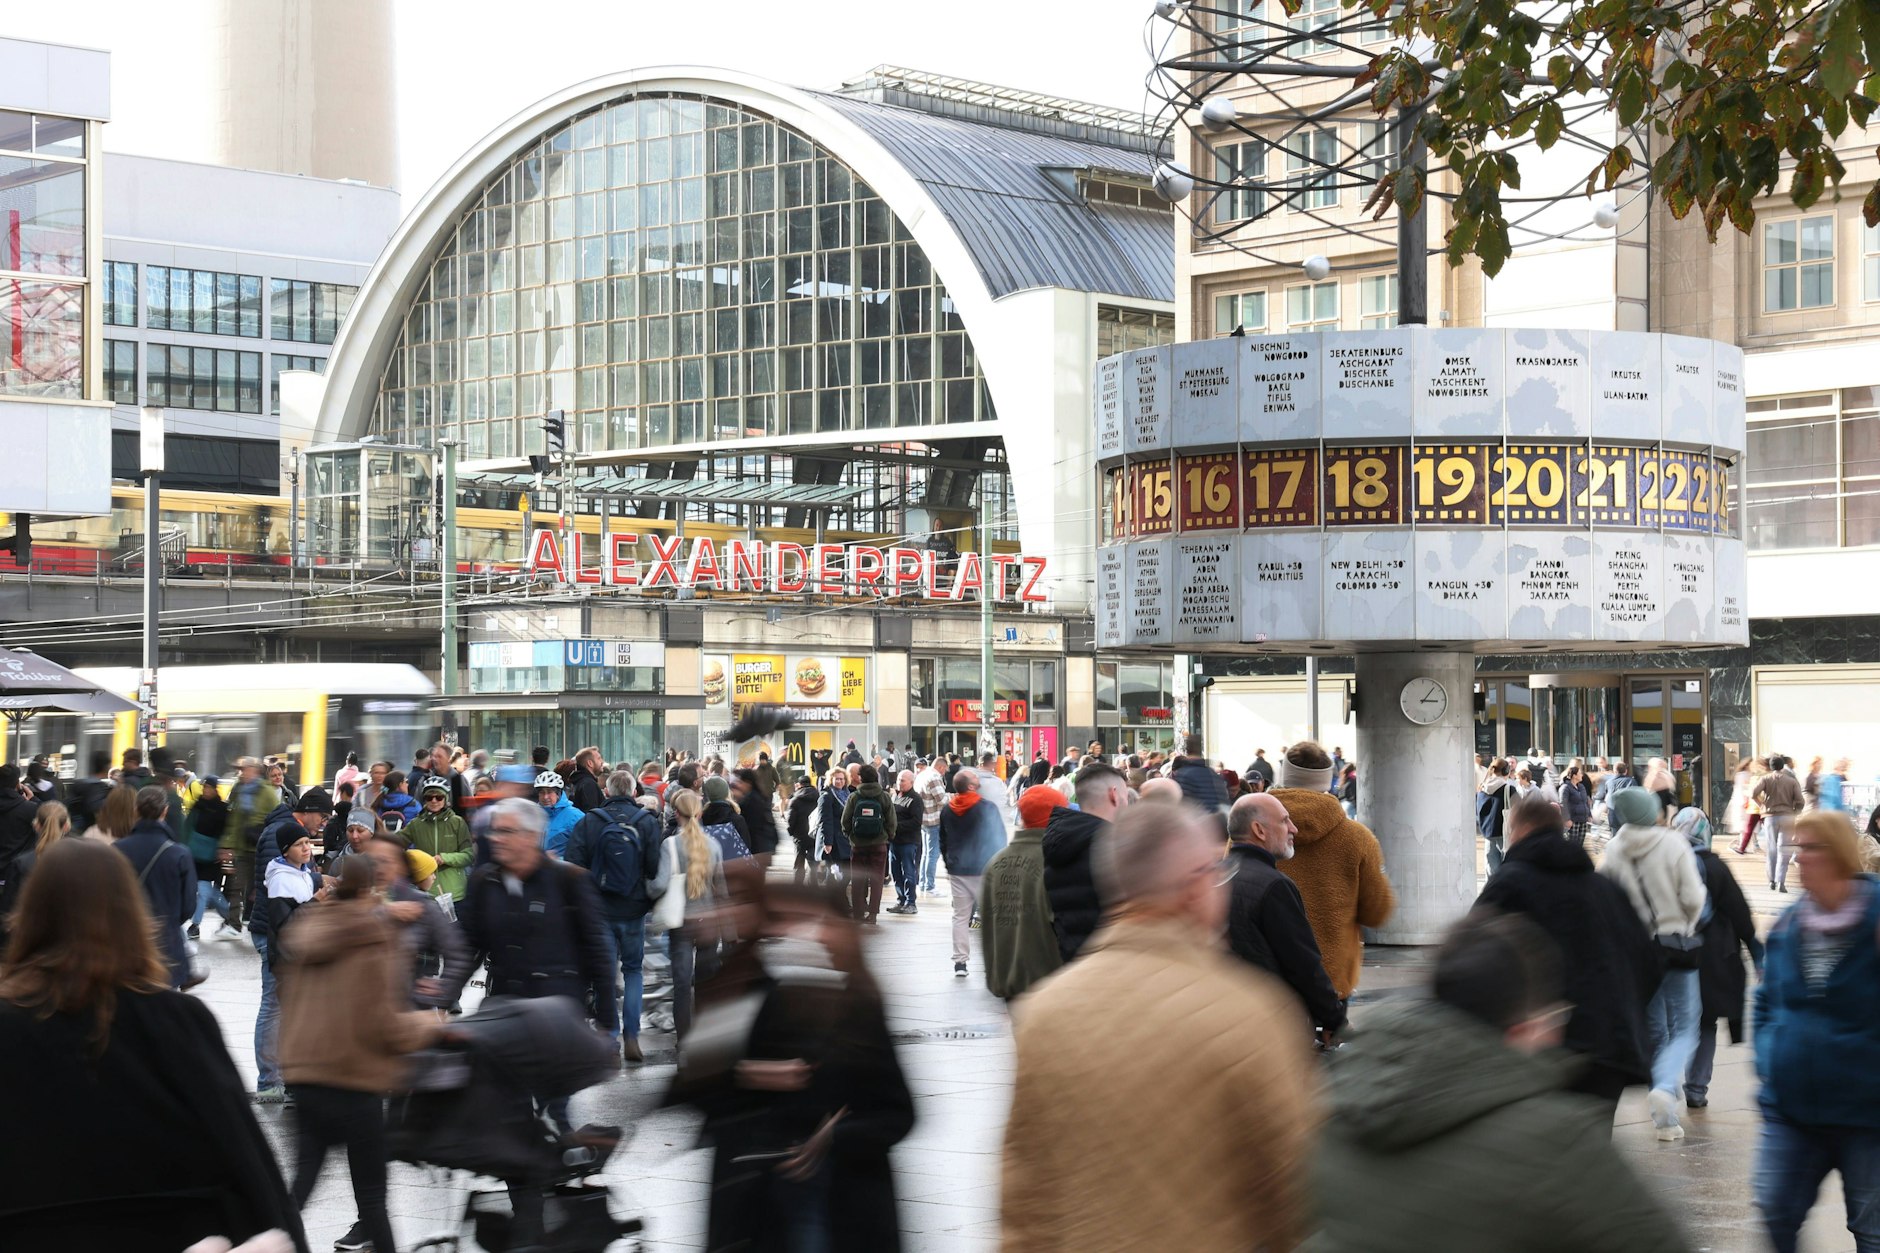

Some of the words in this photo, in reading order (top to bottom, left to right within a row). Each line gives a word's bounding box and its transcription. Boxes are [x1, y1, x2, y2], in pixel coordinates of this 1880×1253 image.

[1251, 342, 1289, 351] NISCHNIJ
[1265, 352, 1307, 361] NOWGOROD
[1330, 348, 1402, 357] JEKATERINBURG
[1136, 355, 1157, 365] HELSINKI
[1339, 359, 1394, 367] ASCHGABAT
[1517, 358, 1577, 366] KRASNOJARSK
[1141, 366, 1152, 374] RIGA
[1185, 367, 1223, 378] MURMANSK
[1345, 369, 1387, 378] BISCHKEK
[1676, 365, 1699, 374] JAKUTSK
[1255, 372, 1304, 382] WOLGOGRAD
[1612, 371, 1641, 379] IRKUTSK
[1137, 375, 1156, 384] TALLINN
[1190, 377, 1228, 387] PETERSBURG
[1339, 379, 1393, 388] DUSCHANBE
[1432, 378, 1485, 386] TASCHKENT
[1139, 386, 1154, 394] WILNA
[1191, 388, 1218, 397] MOSKAU
[1268, 393, 1291, 402] TIFLIS
[1603, 391, 1649, 401] ULAN-BATOR
[1264, 404, 1294, 412] ERIWAN
[1135, 414, 1159, 425] BUKAREST
[1142, 471, 1171, 519] 15
[1186, 465, 1231, 513] 16
[1250, 460, 1306, 509] 17
[1328, 458, 1389, 508] 18
[1414, 457, 1475, 506] 19
[1492, 457, 1564, 507] 20
[1577, 459, 1626, 507] 21
[1641, 461, 1687, 511] 22
[1181, 545, 1213, 553] TEHERAN
[1193, 555, 1219, 563] BAGDAD
[1616, 551, 1640, 559] PEKING
[529, 529, 1048, 602] ALEXANDERPLATZ
[1137, 558, 1159, 567] ISTANBUL
[1674, 563, 1704, 572] PJÖNGJANG
[1260, 573, 1303, 581] MAURITIUS
[1347, 571, 1389, 579] KARACHI
[1614, 572, 1642, 580] MANILA
[1147, 578, 1158, 586] AVIV
[1336, 582, 1376, 590] COLOMBO
[1618, 582, 1639, 590] PERTH
[1208, 585, 1229, 593] ABEBA
[1682, 584, 1696, 592] SEOUL
[1135, 588, 1161, 597] JERUSALEM
[1140, 598, 1155, 606] BEIRUT
[1183, 596, 1229, 604] MOGADISCHU
[1135, 608, 1160, 616] DAMASKUS
[1183, 606, 1229, 614] DARESSALAM
[1179, 616, 1234, 624] ANTANANARIVO
[1136, 628, 1160, 636] KAPSTADT
[1194, 626, 1219, 634] KUWAIT
[568, 643, 581, 664] U
[619, 656, 630, 664] U5
[736, 662, 772, 673] BURGER
[1, 673, 63, 681] Tchibo
[753, 673, 782, 683] MITTE?
[842, 679, 862, 687] LIEBE
[737, 683, 762, 694] BITTE!
[842, 688, 854, 696] ES!
[605, 697, 611, 705] U
